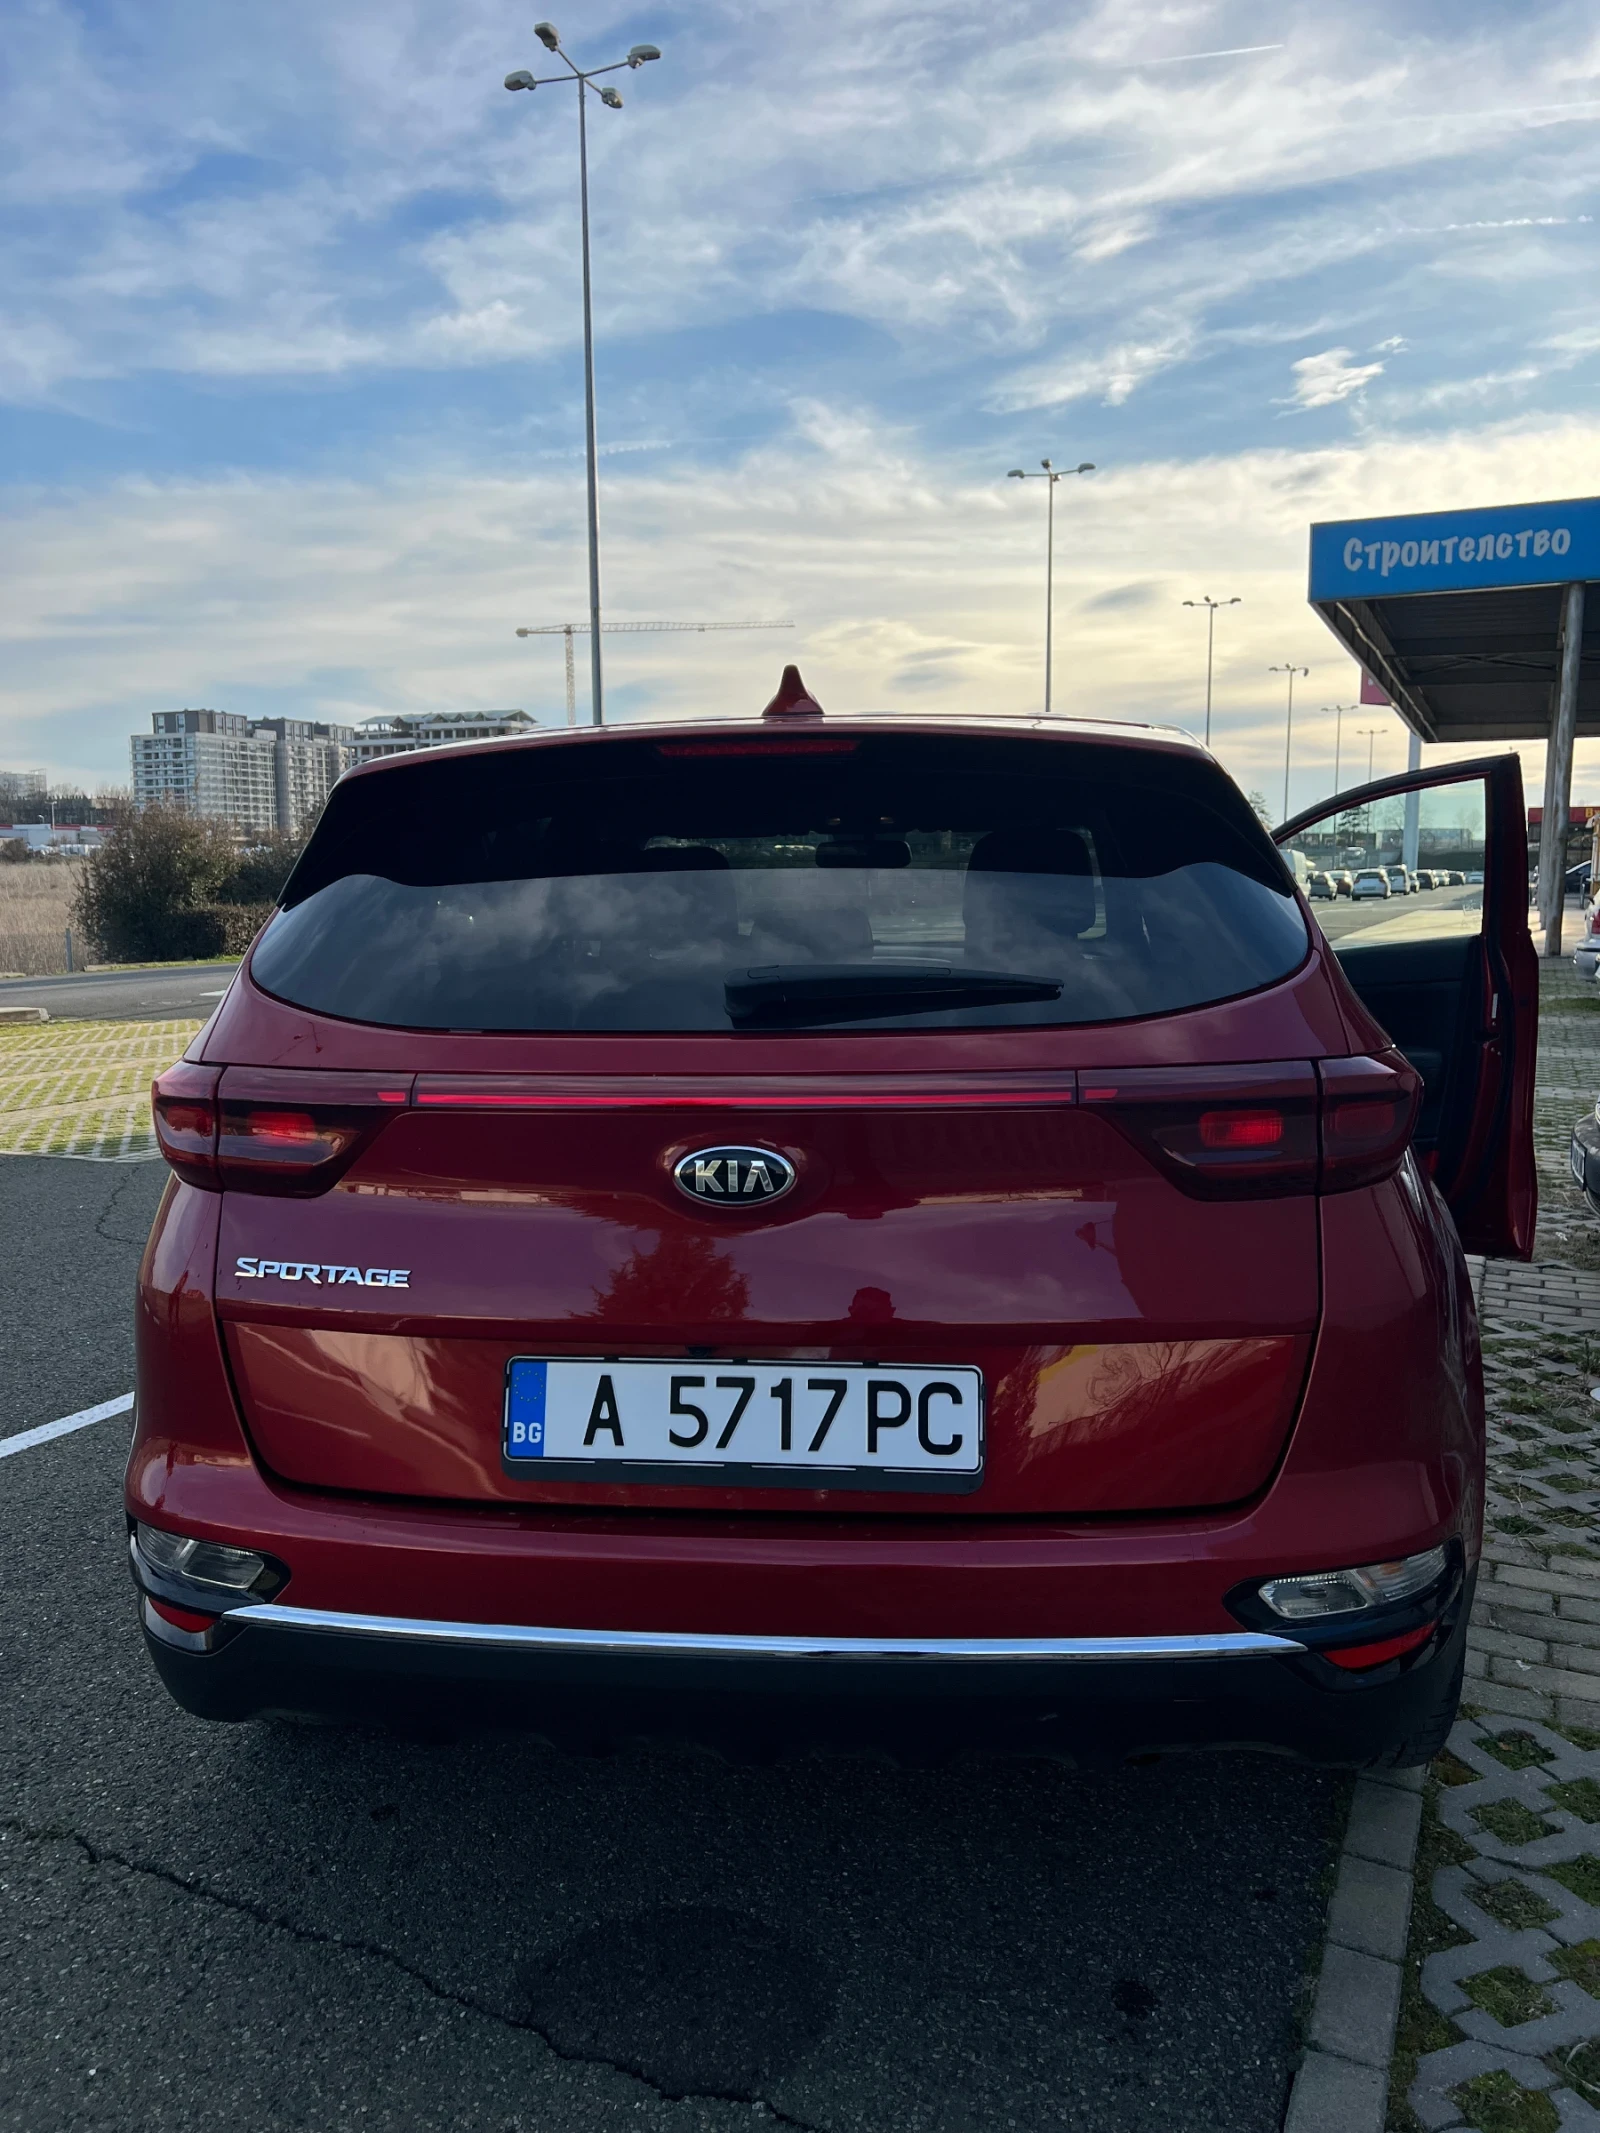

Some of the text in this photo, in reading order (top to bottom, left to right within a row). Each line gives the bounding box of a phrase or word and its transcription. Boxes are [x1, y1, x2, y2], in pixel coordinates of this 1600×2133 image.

[1343, 528, 1571, 577] Строителство
[693, 1159, 775, 1194] KIA
[234, 1256, 411, 1289] SPORTAGE
[582, 1374, 625, 1447] A
[512, 1420, 543, 1444] BG
